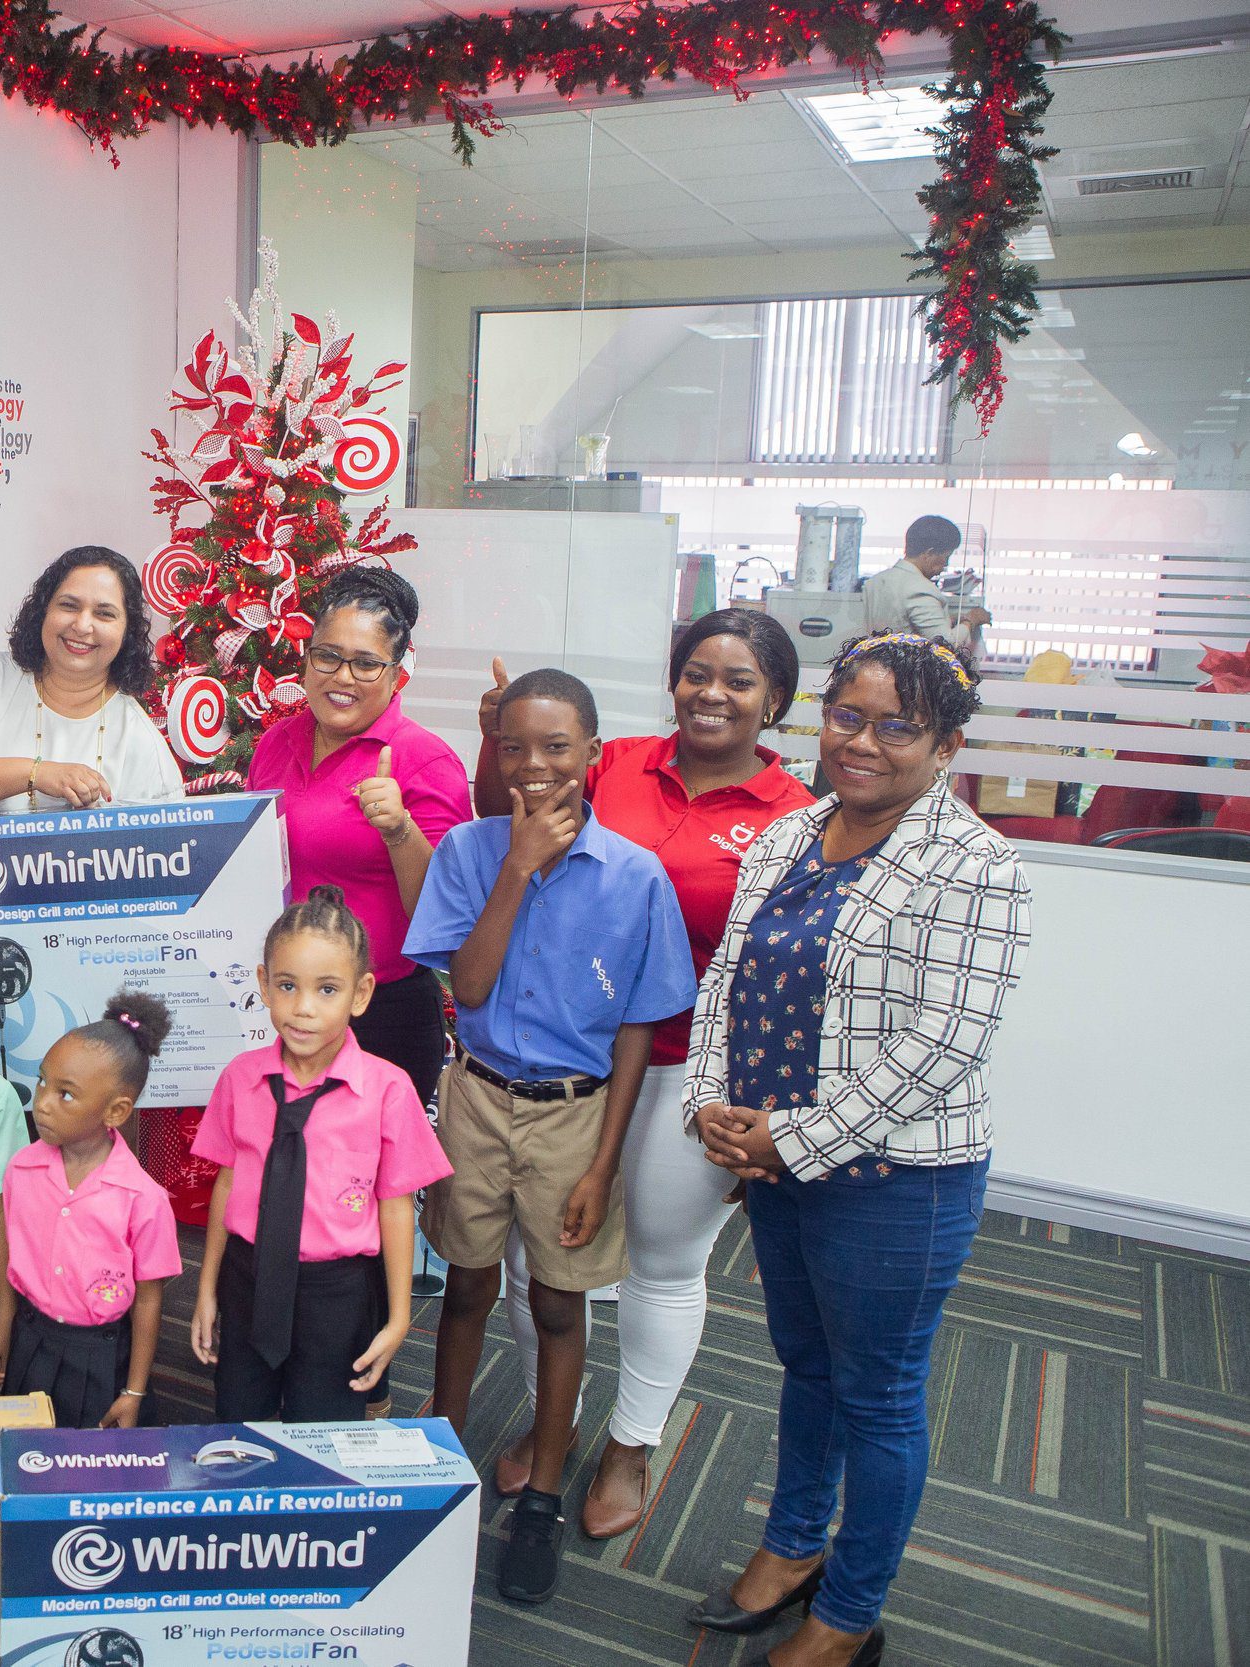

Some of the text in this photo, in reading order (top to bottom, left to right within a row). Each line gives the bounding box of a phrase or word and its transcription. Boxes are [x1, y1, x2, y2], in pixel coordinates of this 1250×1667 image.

[4, 379, 22, 394] the
[1, 448, 16, 460] the
[59, 817, 82, 831] An
[86, 814, 113, 829] Air
[118, 807, 214, 827] Revolution
[708, 833, 746, 859] Digice
[38, 904, 62, 918] Grill
[64, 903, 85, 916] and
[88, 901, 119, 915] Quiet
[122, 900, 178, 915] operation
[66, 935, 92, 948] High
[96, 931, 168, 945] Performance
[173, 929, 233, 941] Oscillating
[124, 967, 166, 978] Adjustable
[124, 978, 149, 989] Height
[150, 1091, 179, 1099] Required
[423, 1470, 456, 1478] Height
[69, 1491, 403, 1520] Experience An Air Revolution
[42, 1592, 341, 1613] Modern Design Grill and Quiet operation
[192, 1626, 226, 1640] High
[230, 1626, 325, 1638] Performance
[330, 1624, 405, 1638] Oscillating
